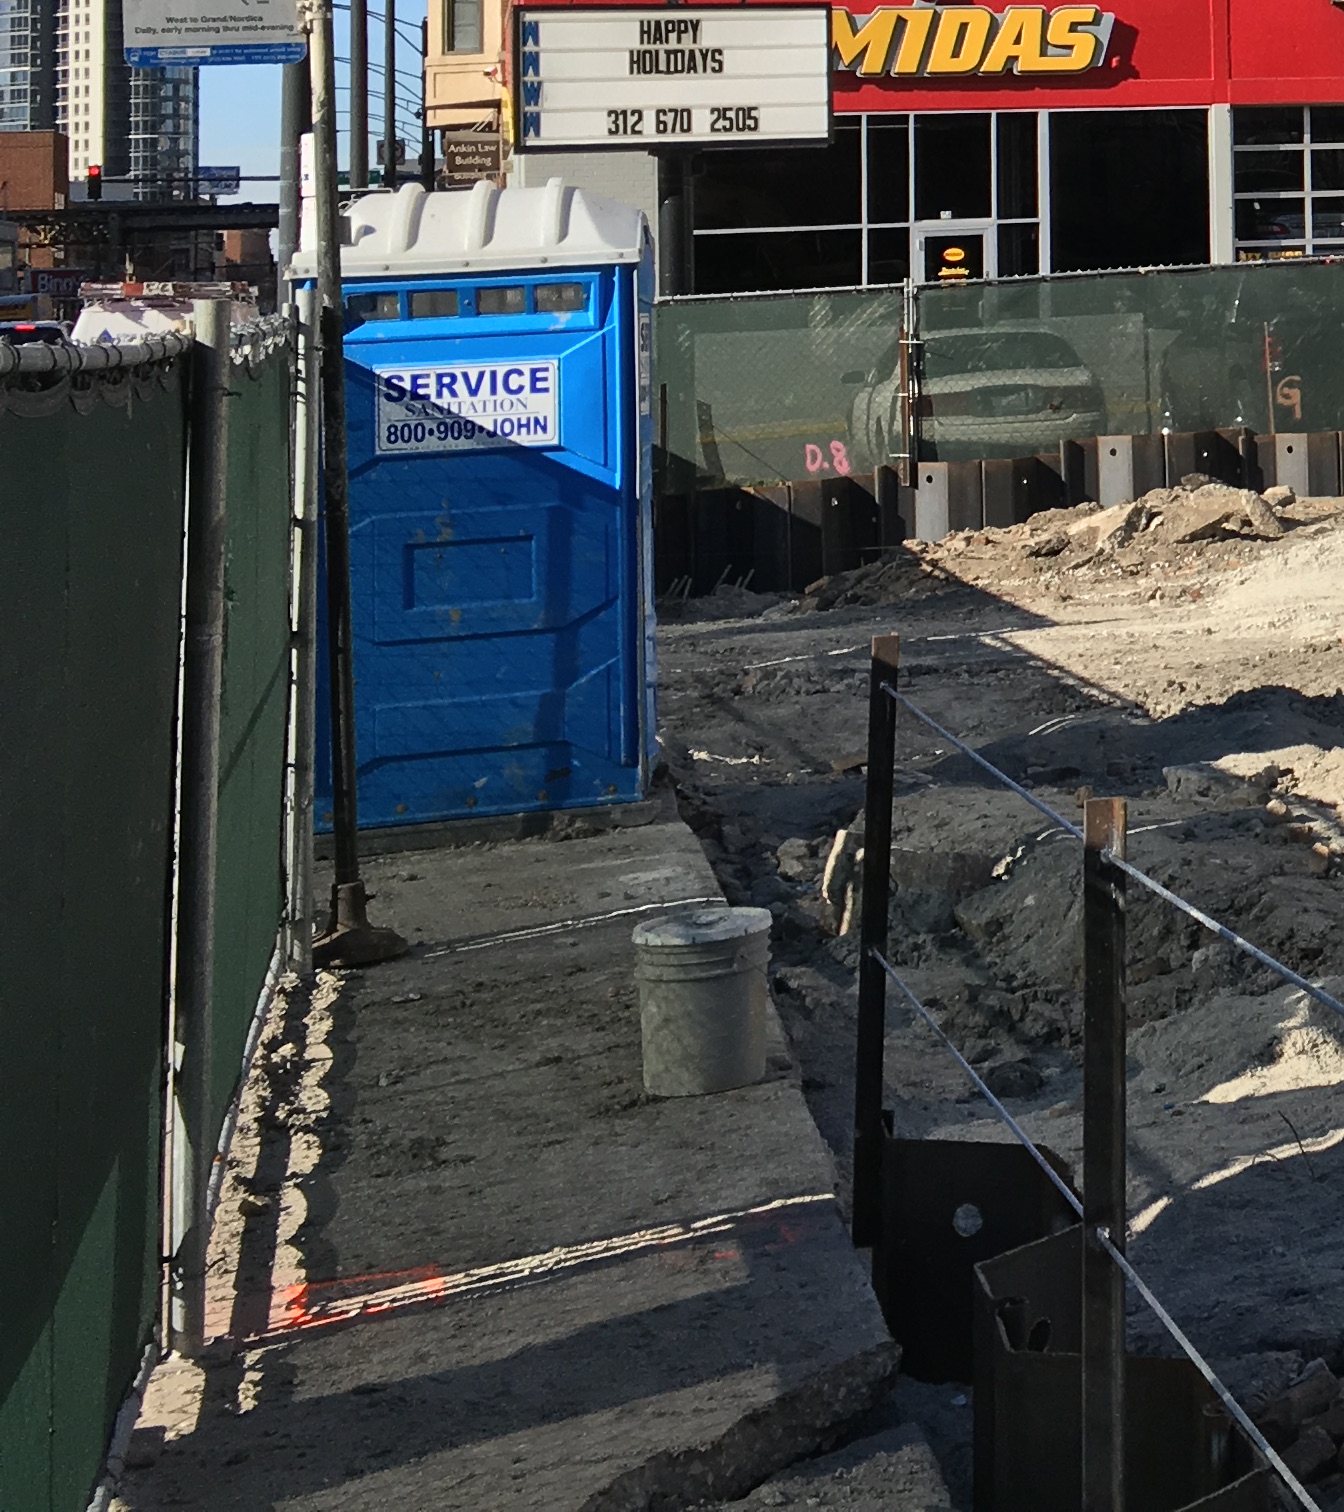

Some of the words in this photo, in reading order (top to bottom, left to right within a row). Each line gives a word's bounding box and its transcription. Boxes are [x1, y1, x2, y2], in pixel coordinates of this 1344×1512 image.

[639, 19, 701, 45] HAPPY
[629, 49, 723, 75] HOLIDAYS
[607, 108, 643, 135] 312
[655, 108, 692, 134] 670
[710, 107, 759, 132] 2505
[448, 144, 476, 153] Ankin
[478, 144, 497, 153] Law
[455, 155, 492, 166] Building
[383, 367, 550, 403] SERVICE
[405, 397, 528, 417] SANITATION
